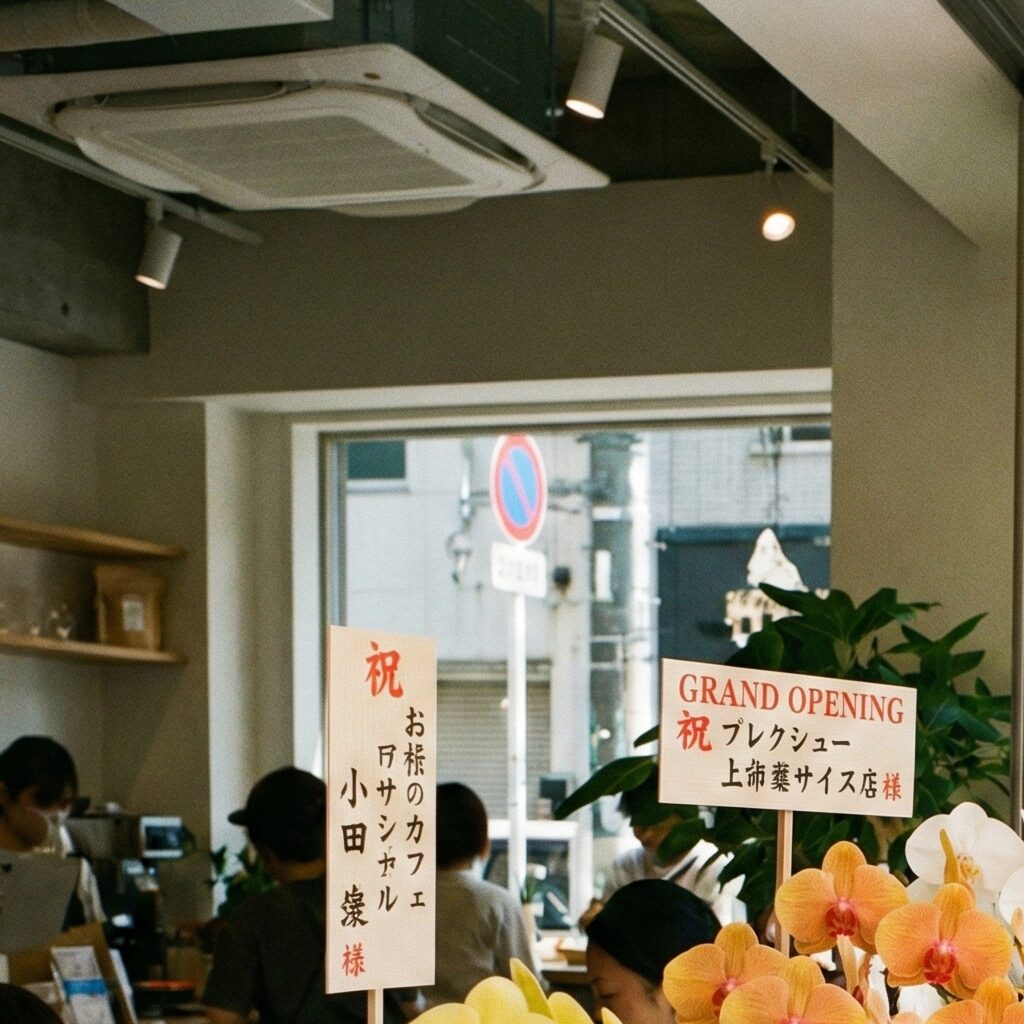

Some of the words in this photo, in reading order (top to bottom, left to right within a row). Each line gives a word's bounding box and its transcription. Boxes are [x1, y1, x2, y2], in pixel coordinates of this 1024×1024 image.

[365, 641, 404, 698] 祝
[678, 673, 780, 712] GRAND
[787, 685, 905, 724] OPENING
[676, 709, 713, 751] 祝
[721, 717, 851, 753] プレクシュー
